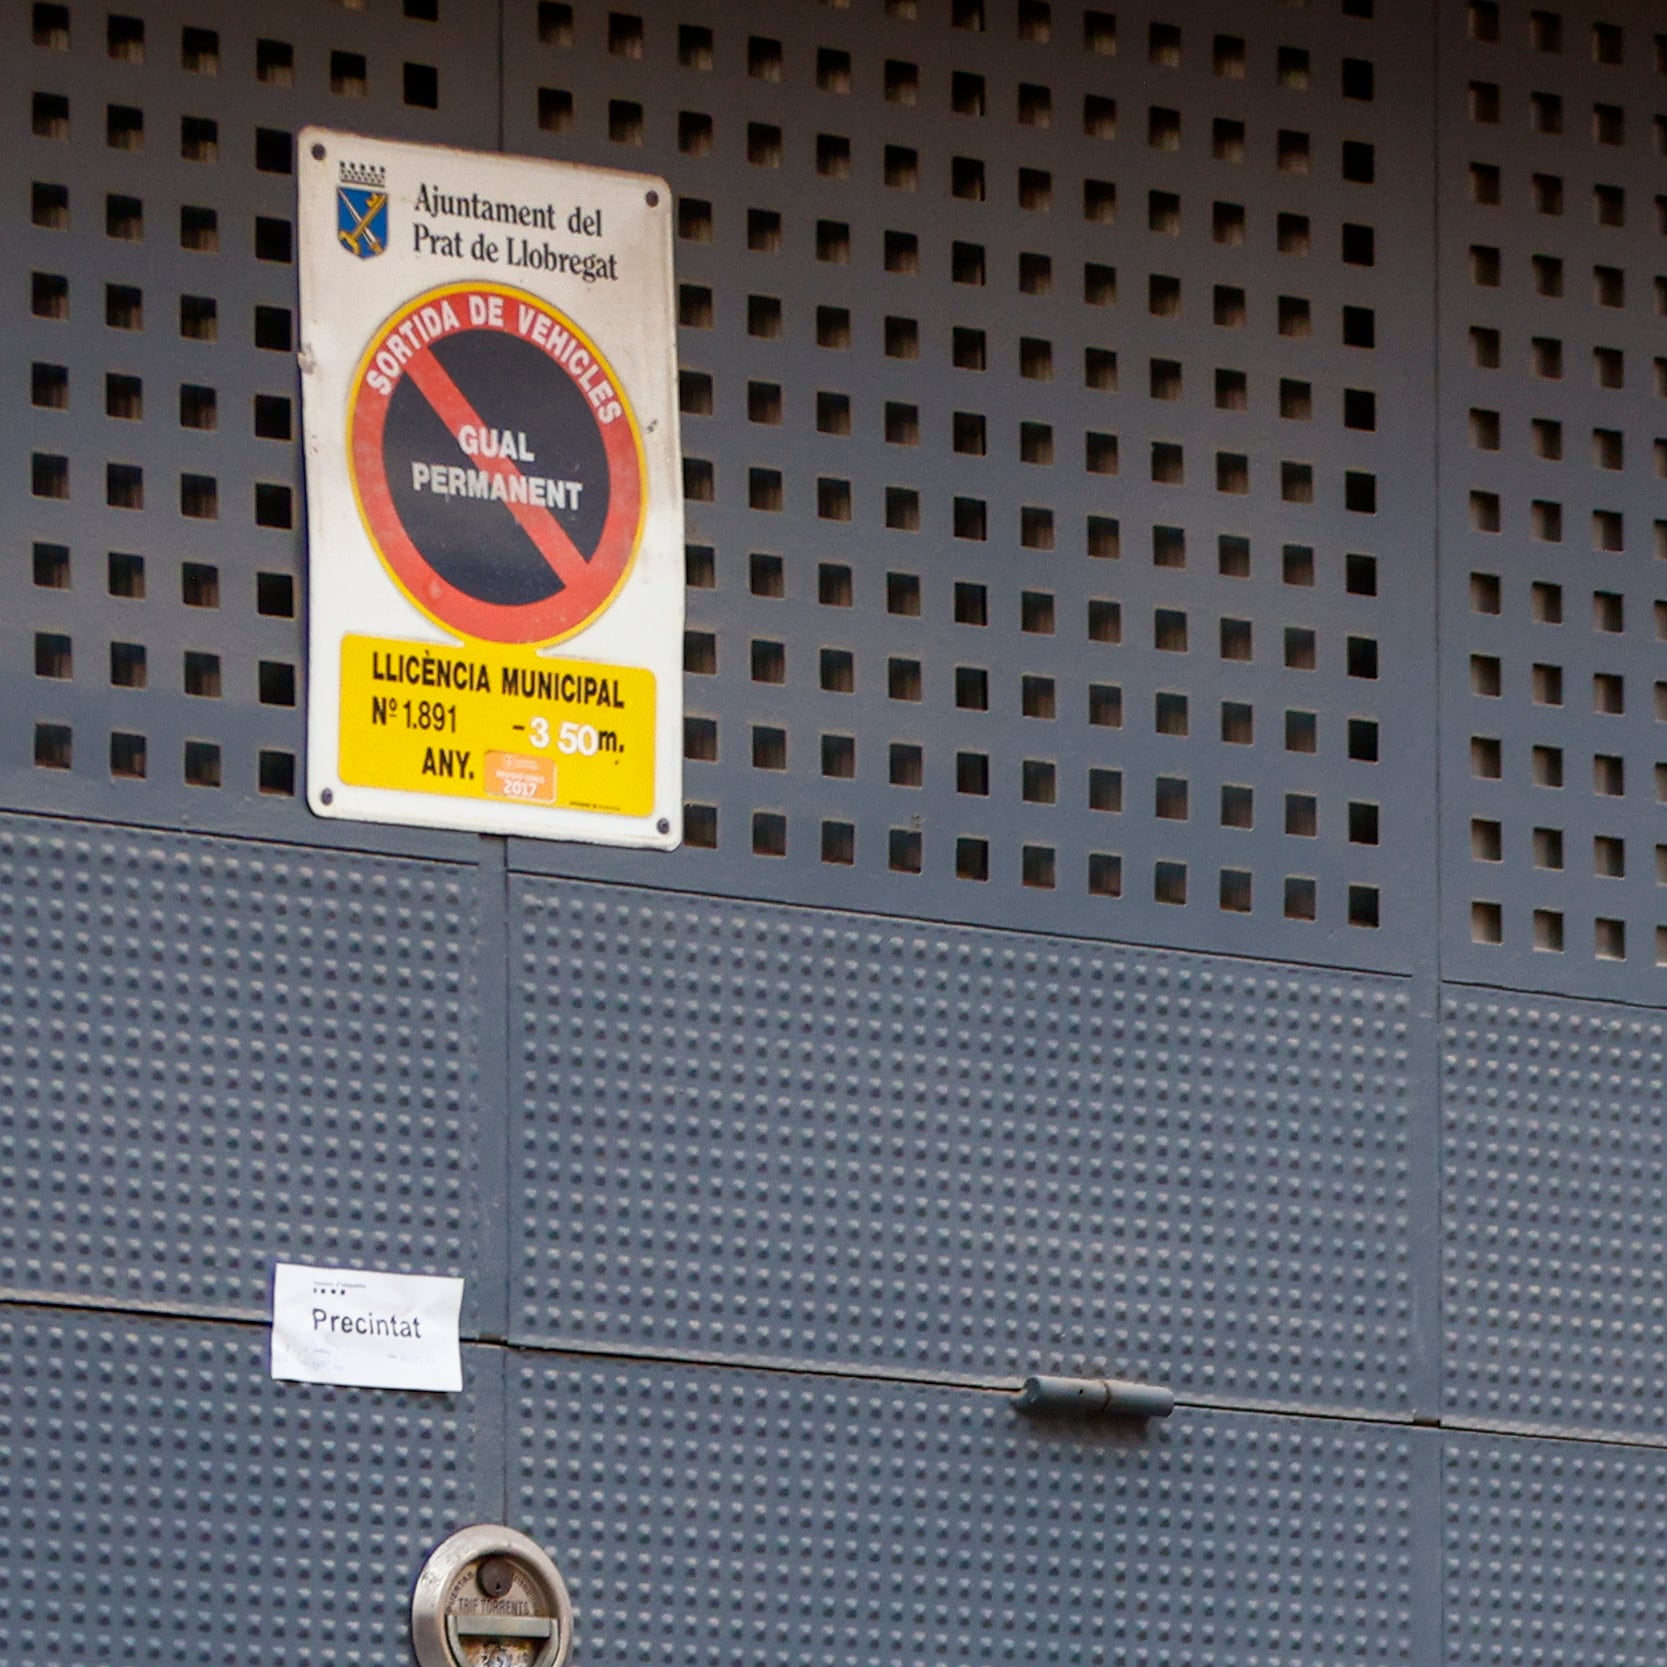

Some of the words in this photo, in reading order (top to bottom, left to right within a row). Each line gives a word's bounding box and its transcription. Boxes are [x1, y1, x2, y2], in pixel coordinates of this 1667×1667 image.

[414, 182, 556, 231] Ajuntament
[567, 205, 603, 238] del
[412, 222, 463, 259] Prat
[470, 233, 499, 264] de
[506, 236, 619, 284] Llobregat
[366, 299, 460, 396] SORTIDA
[468, 294, 505, 328] DE
[517, 303, 623, 424] VEHICLES
[457, 424, 536, 463] GUAL
[411, 461, 584, 511] PERMANENT
[372, 649, 491, 694] LLICÈNCIA
[501, 666, 626, 709] MUNICIPAL
[402, 700, 457, 734] 1.891
[421, 746, 475, 780] ANY.
[503, 779, 538, 798] 2017
[312, 1308, 422, 1340] Precintat
